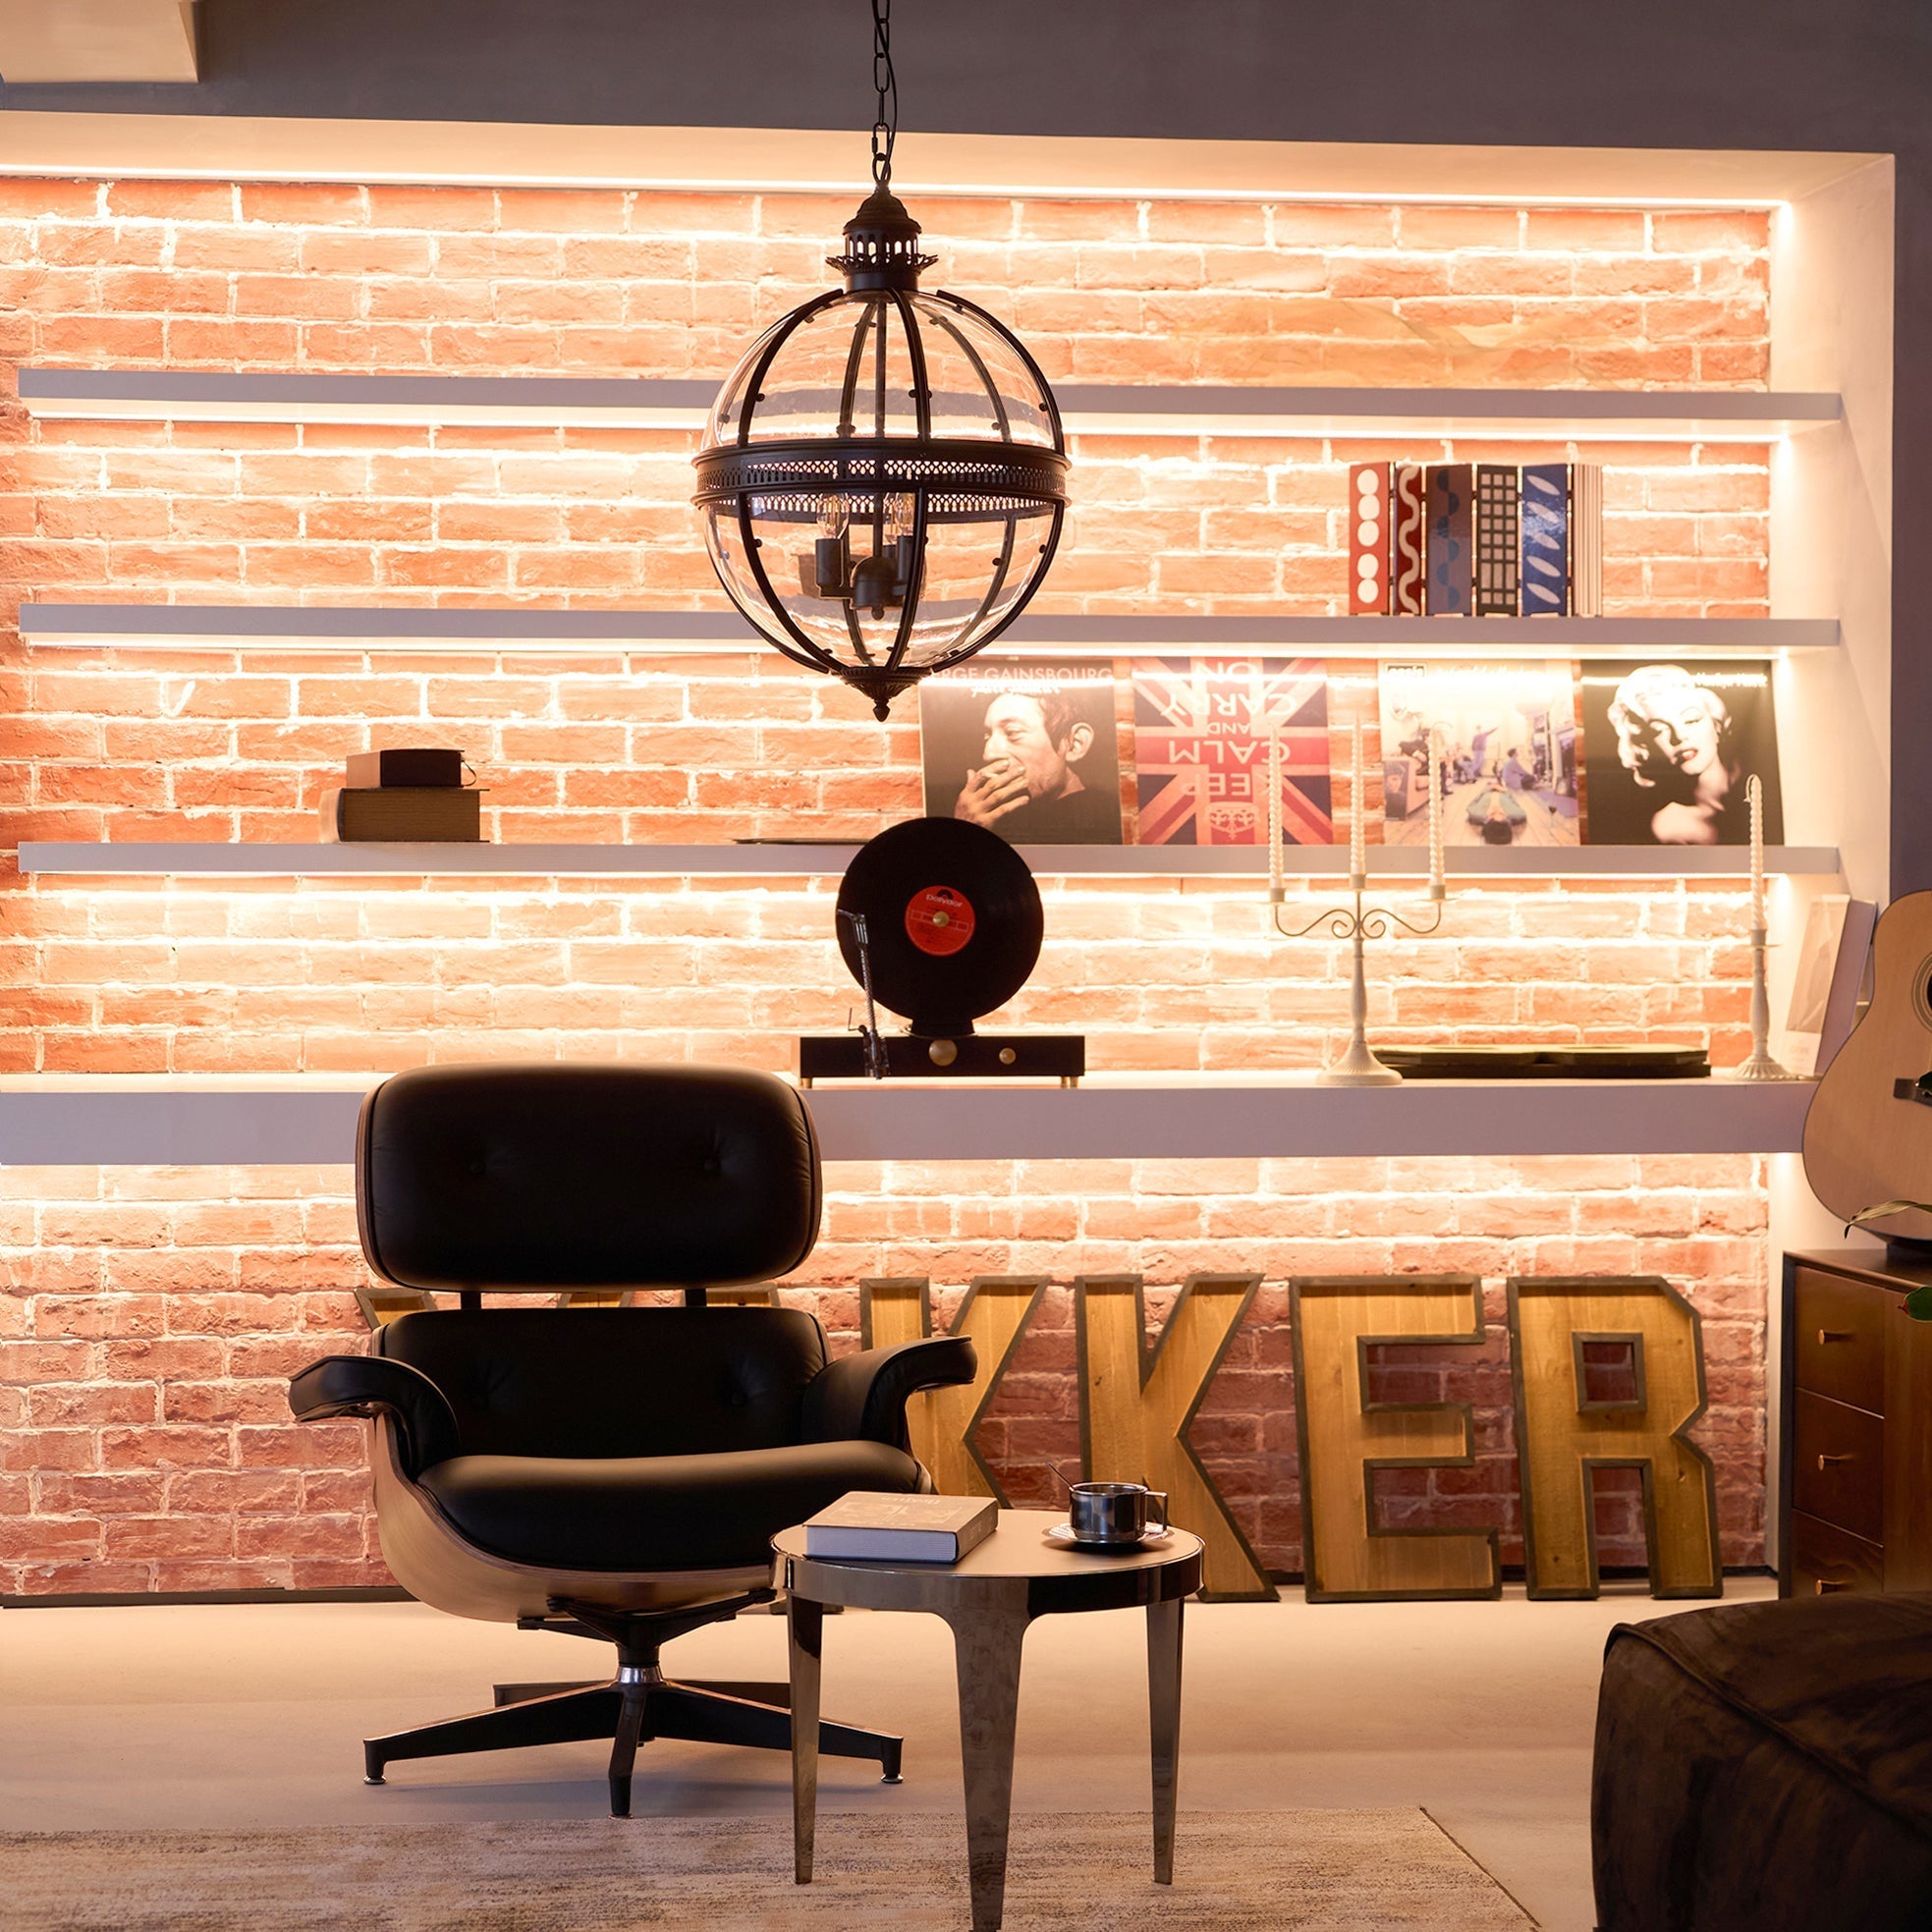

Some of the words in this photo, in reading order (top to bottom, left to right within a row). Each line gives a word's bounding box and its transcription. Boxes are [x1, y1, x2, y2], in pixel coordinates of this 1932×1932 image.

[984, 667, 1114, 681] GAINSBOURG
[1194, 661, 1261, 684] ON
[1160, 692, 1297, 717] CARRY
[1206, 721, 1251, 735] AND
[1168, 740, 1292, 764] CALM
[355, 1272, 1723, 1604] KKER
